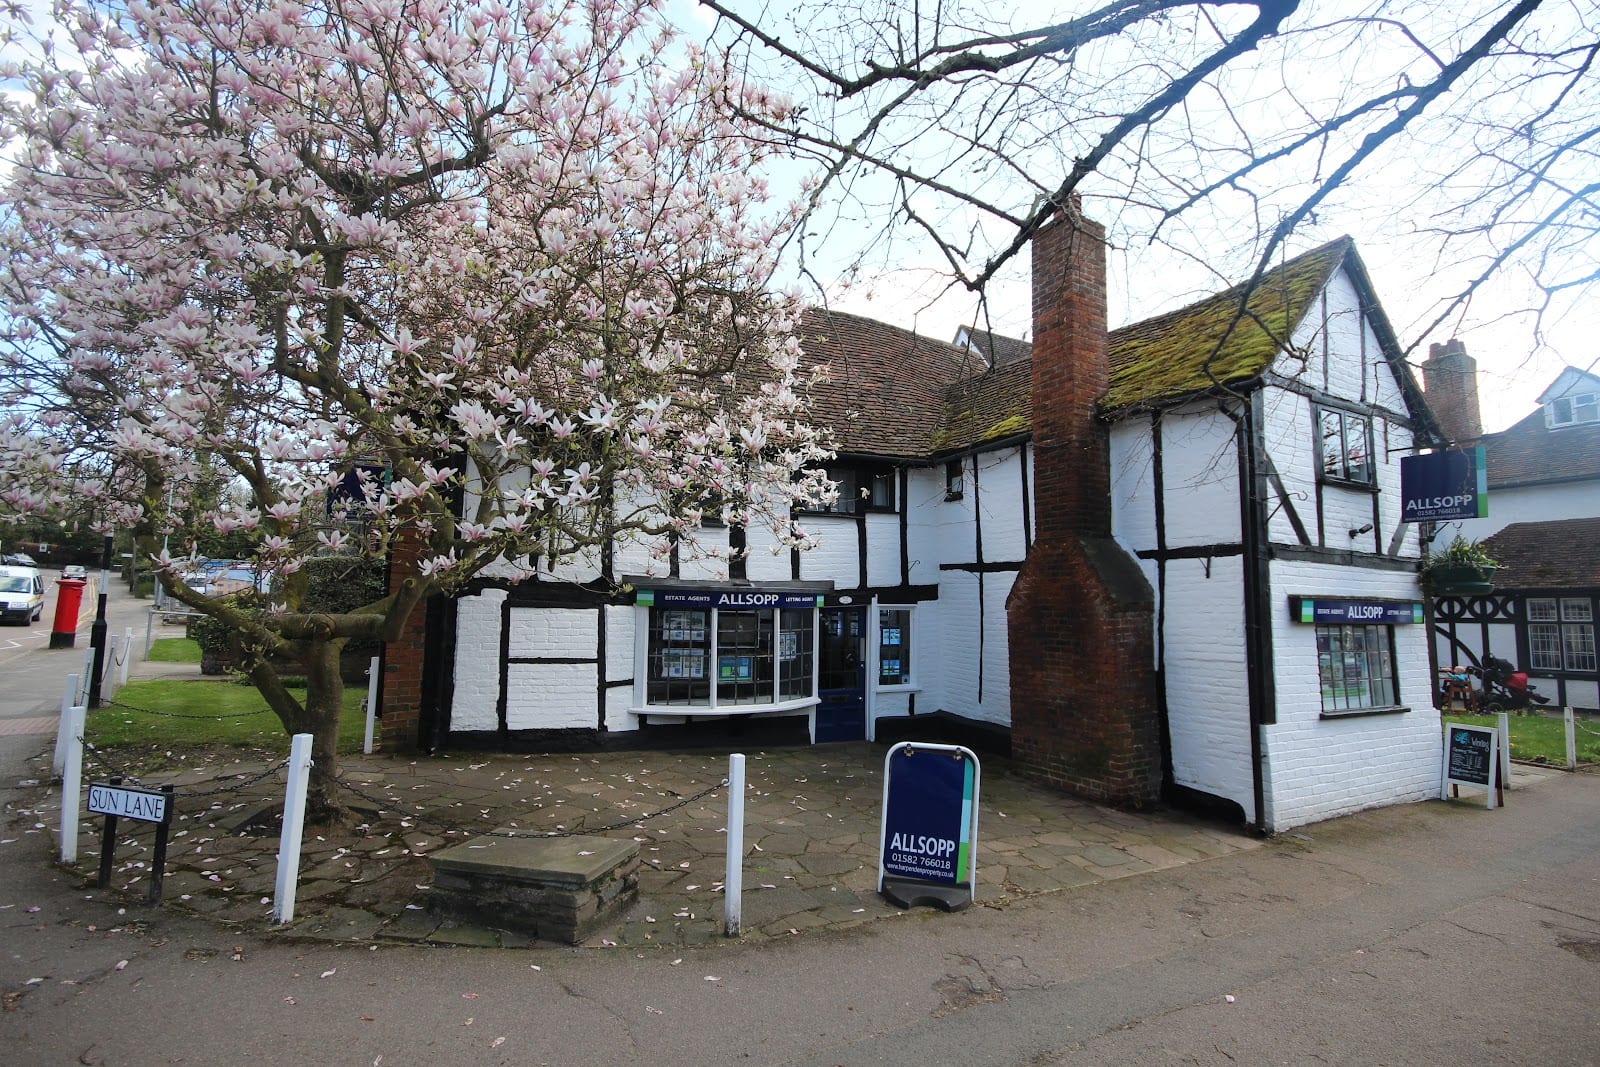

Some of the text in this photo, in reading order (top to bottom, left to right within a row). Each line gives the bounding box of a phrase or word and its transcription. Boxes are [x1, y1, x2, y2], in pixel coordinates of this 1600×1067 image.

[1406, 495, 1472, 510] ALLSOPP
[718, 593, 779, 605] ALLSOPP
[1347, 605, 1384, 619] ALLSOPP
[91, 789, 163, 819] SUN LANE
[890, 832, 956, 858] ALLSOPP
[892, 852, 951, 870] 01582 766018
[886, 863, 955, 878] www.harpendenproperty.co.uk
